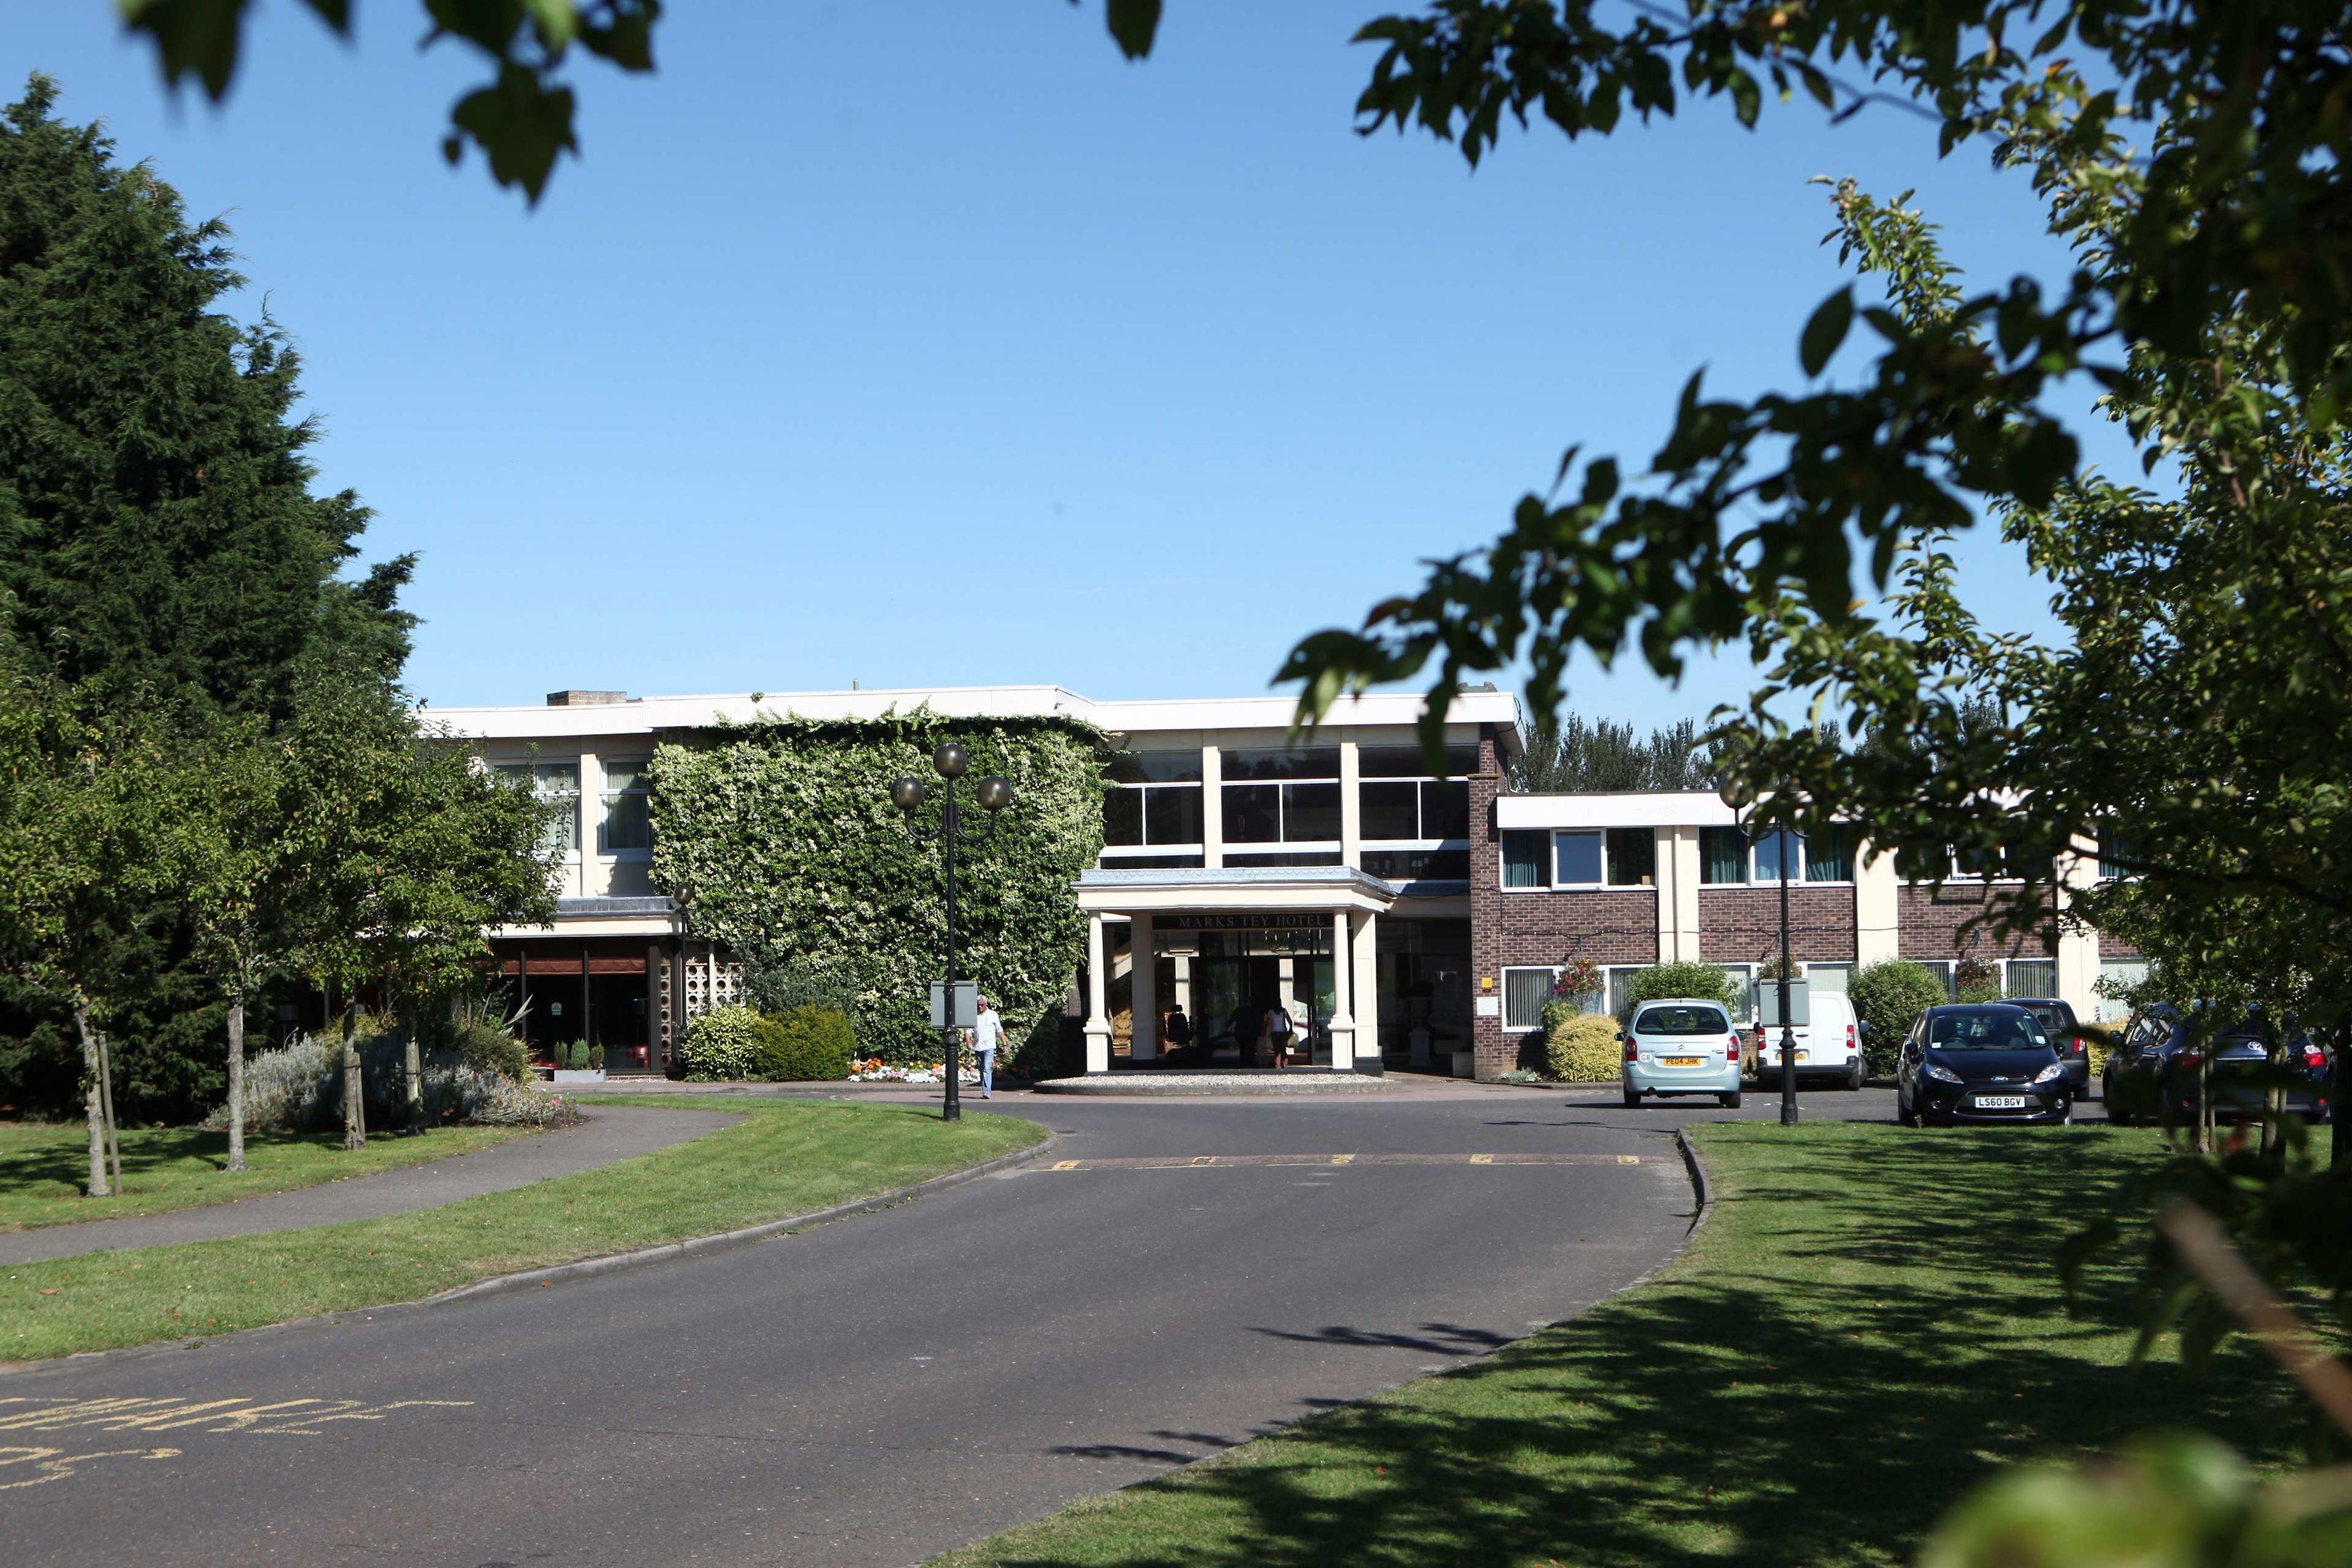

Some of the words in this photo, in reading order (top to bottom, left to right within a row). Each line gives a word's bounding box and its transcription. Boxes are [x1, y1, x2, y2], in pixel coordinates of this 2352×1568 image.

[1179, 916, 1234, 927] MARKS
[1241, 916, 1267, 927] TEY
[1277, 915, 1324, 926] HOTEL
[1979, 1098, 2001, 1106] LS60
[2004, 1098, 2021, 1106] BGV
